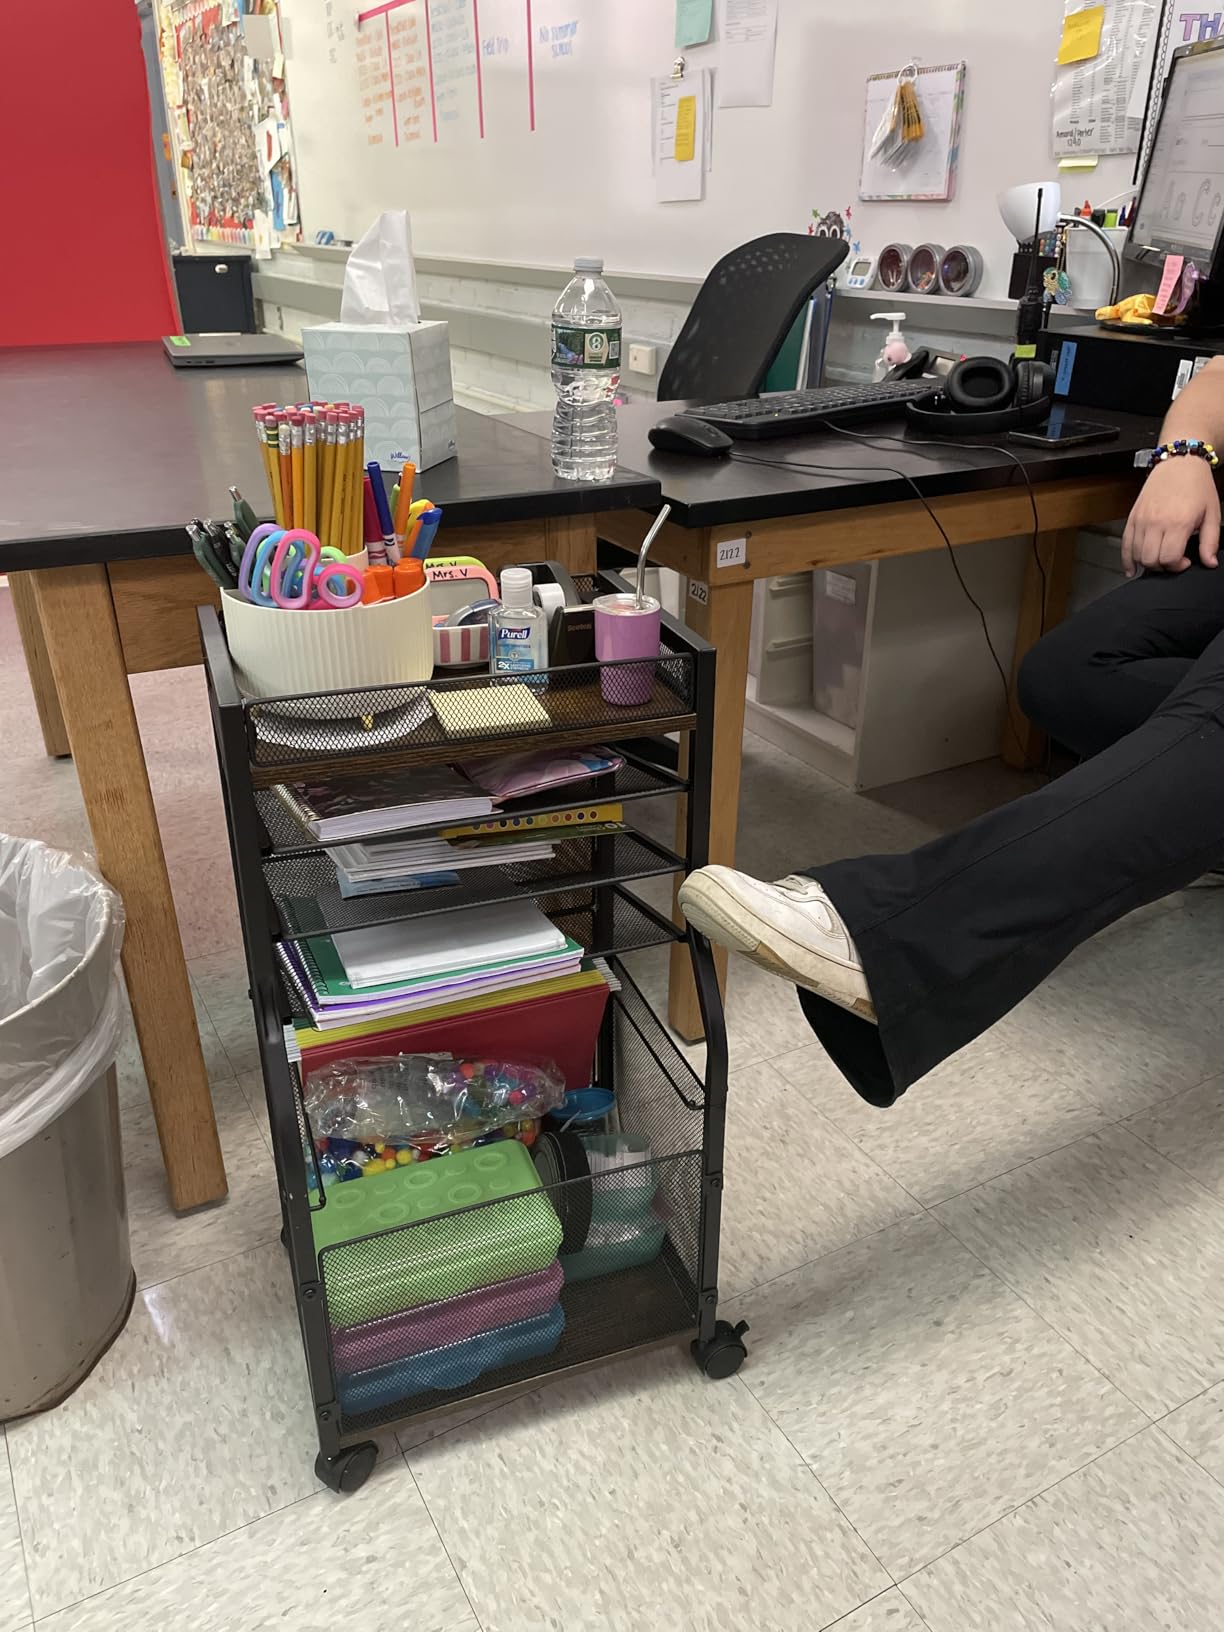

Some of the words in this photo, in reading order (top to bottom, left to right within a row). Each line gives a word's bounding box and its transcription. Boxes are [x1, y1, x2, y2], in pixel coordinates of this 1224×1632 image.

[1179, 12, 1224, 41] TH
[432, 570, 458, 580] Mrs.
[459, 568, 468, 577] V
[501, 629, 528, 639] Purell
